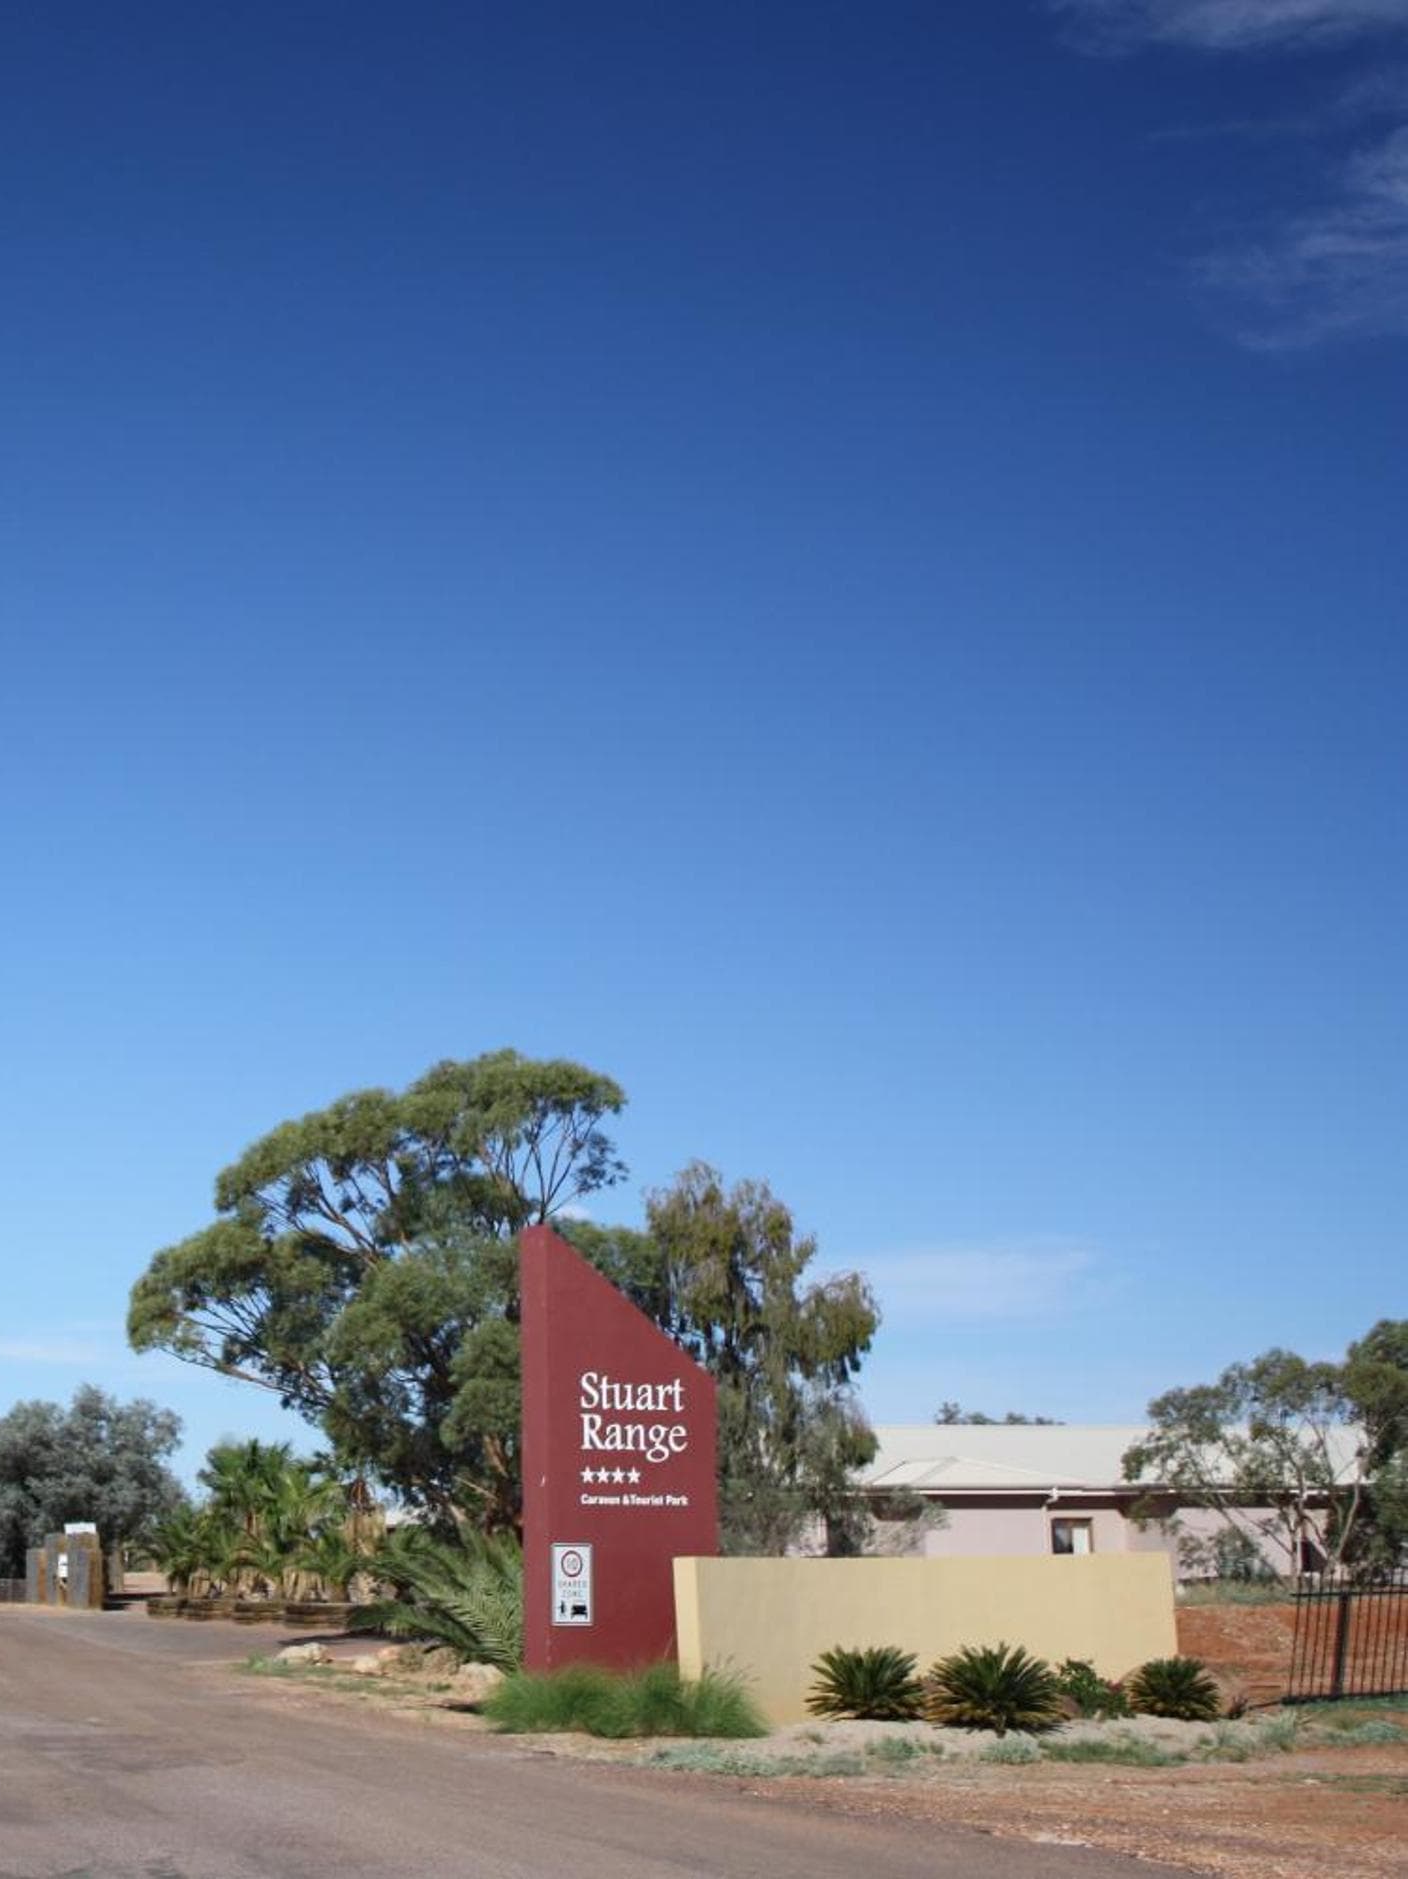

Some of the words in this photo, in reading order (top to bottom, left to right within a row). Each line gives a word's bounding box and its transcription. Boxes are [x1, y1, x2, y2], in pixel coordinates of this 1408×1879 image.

[580, 1371, 685, 1412] Stuart
[580, 1413, 688, 1463] Range
[580, 1493, 620, 1505] Caravan
[630, 1495, 663, 1505] Tourist
[666, 1495, 688, 1506] Park
